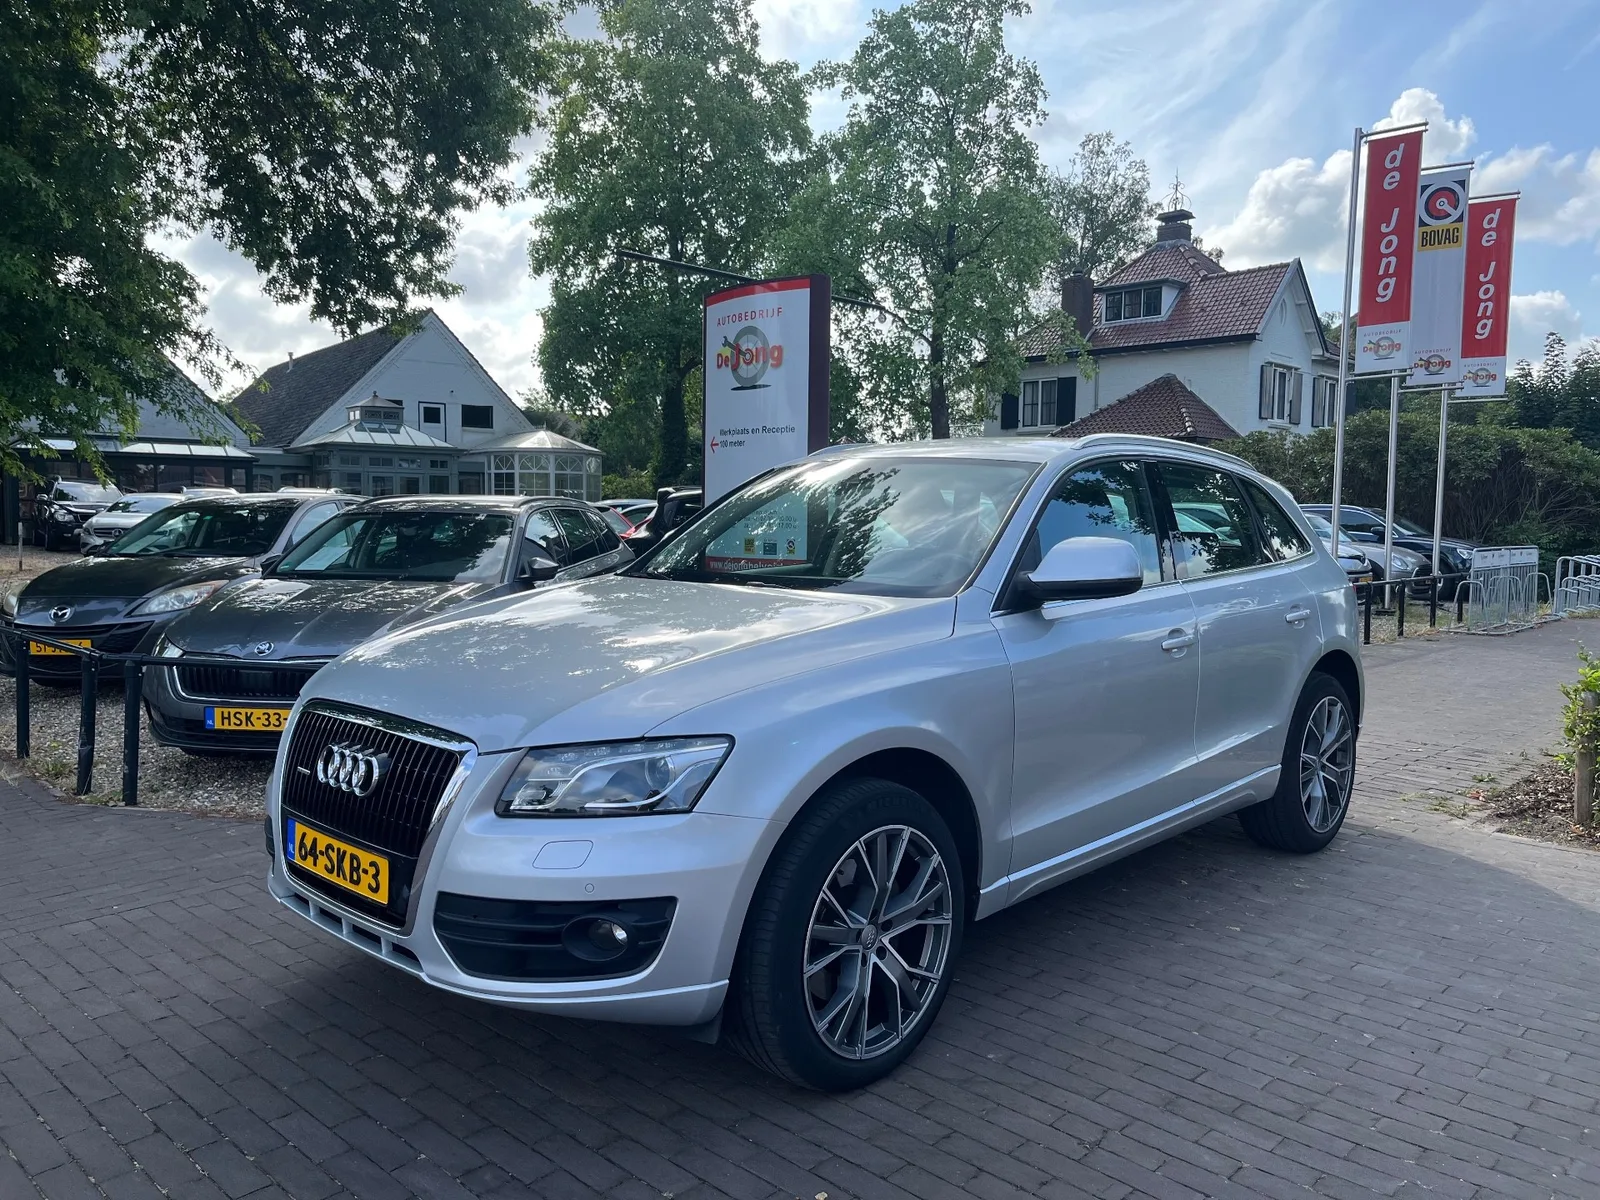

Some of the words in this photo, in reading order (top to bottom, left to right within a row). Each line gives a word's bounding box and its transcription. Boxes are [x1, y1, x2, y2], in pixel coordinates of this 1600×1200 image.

[1383, 142, 1405, 191] de
[1421, 227, 1459, 248] BOVAG
[1481, 208, 1501, 247] de
[1375, 207, 1400, 303] Jong
[1474, 261, 1496, 340] Jong
[716, 307, 783, 327] AUTOBEDRIJF
[719, 427, 750, 437] Werkplaats
[751, 427, 760, 435] en
[761, 424, 796, 435] Receptie
[719, 439, 729, 448] 100
[729, 440, 746, 448] meter
[220, 711, 288, 728] HSK-33-
[297, 831, 381, 894] 64-SKB-3
